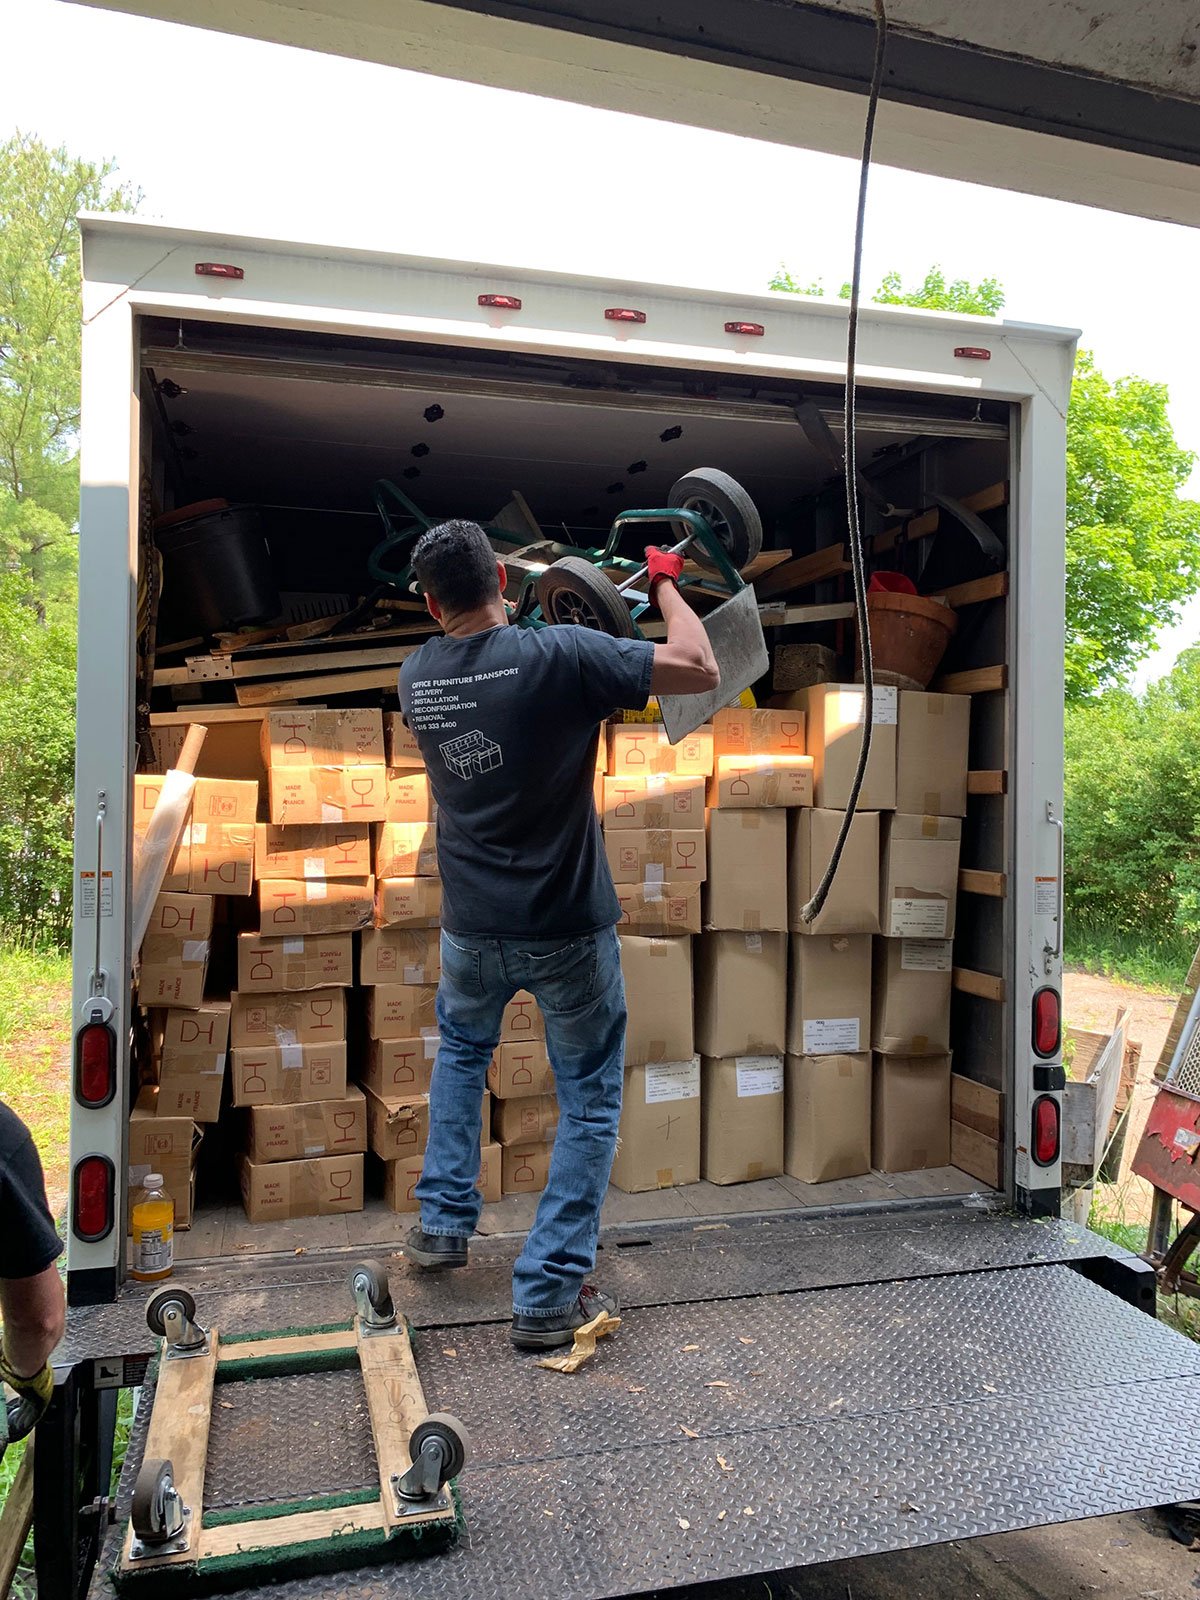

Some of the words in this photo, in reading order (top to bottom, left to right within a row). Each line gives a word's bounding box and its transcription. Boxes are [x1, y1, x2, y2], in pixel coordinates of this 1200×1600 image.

[411, 680, 431, 688] OFFICE
[433, 676, 473, 686] FURNITURE
[474, 668, 519, 681] TRANSPORT
[415, 688, 443, 696] DELIVERY
[414, 695, 459, 705] INSTALLATION
[415, 702, 477, 713] RECONFIGURATION
[415, 714, 445, 722] REMOVAL
[428, 722, 439, 730] 333
[441, 721, 457, 729] 4400
